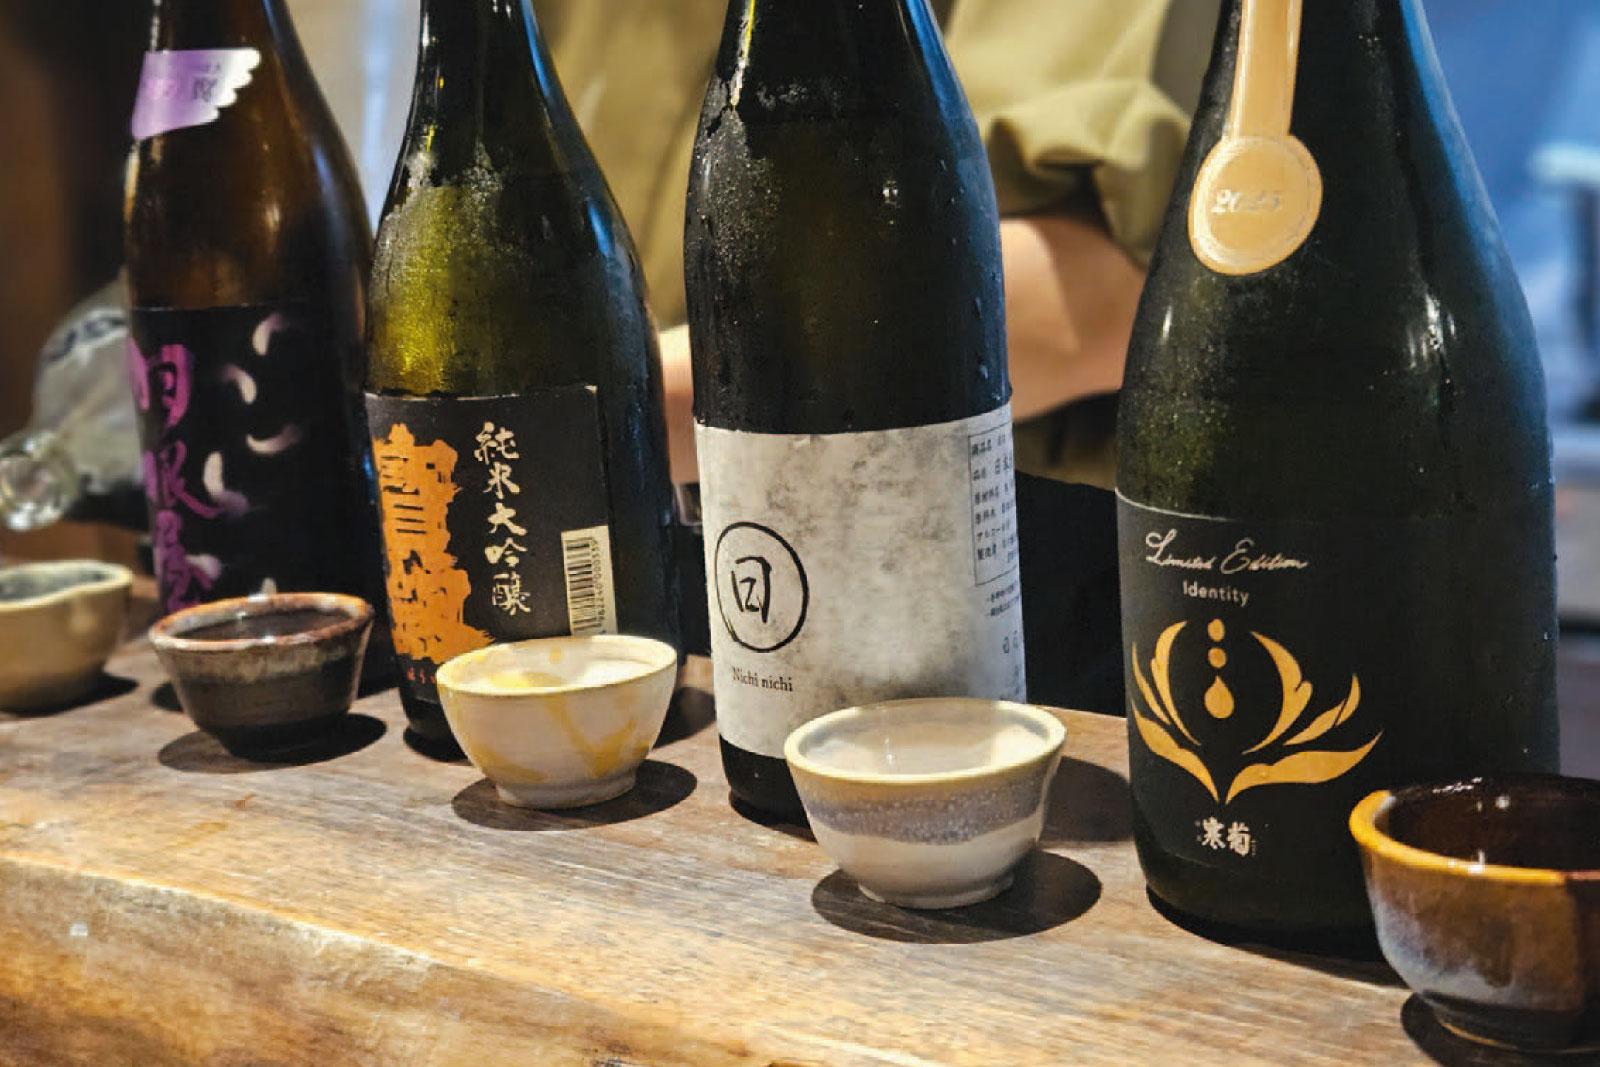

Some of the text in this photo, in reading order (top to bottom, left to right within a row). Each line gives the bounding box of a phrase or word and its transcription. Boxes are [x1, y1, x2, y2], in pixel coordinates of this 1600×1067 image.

[1145, 528, 1309, 575] Limited Edition
[1182, 580, 1249, 607] Identity
[731, 665, 793, 692] Nichi nichi
